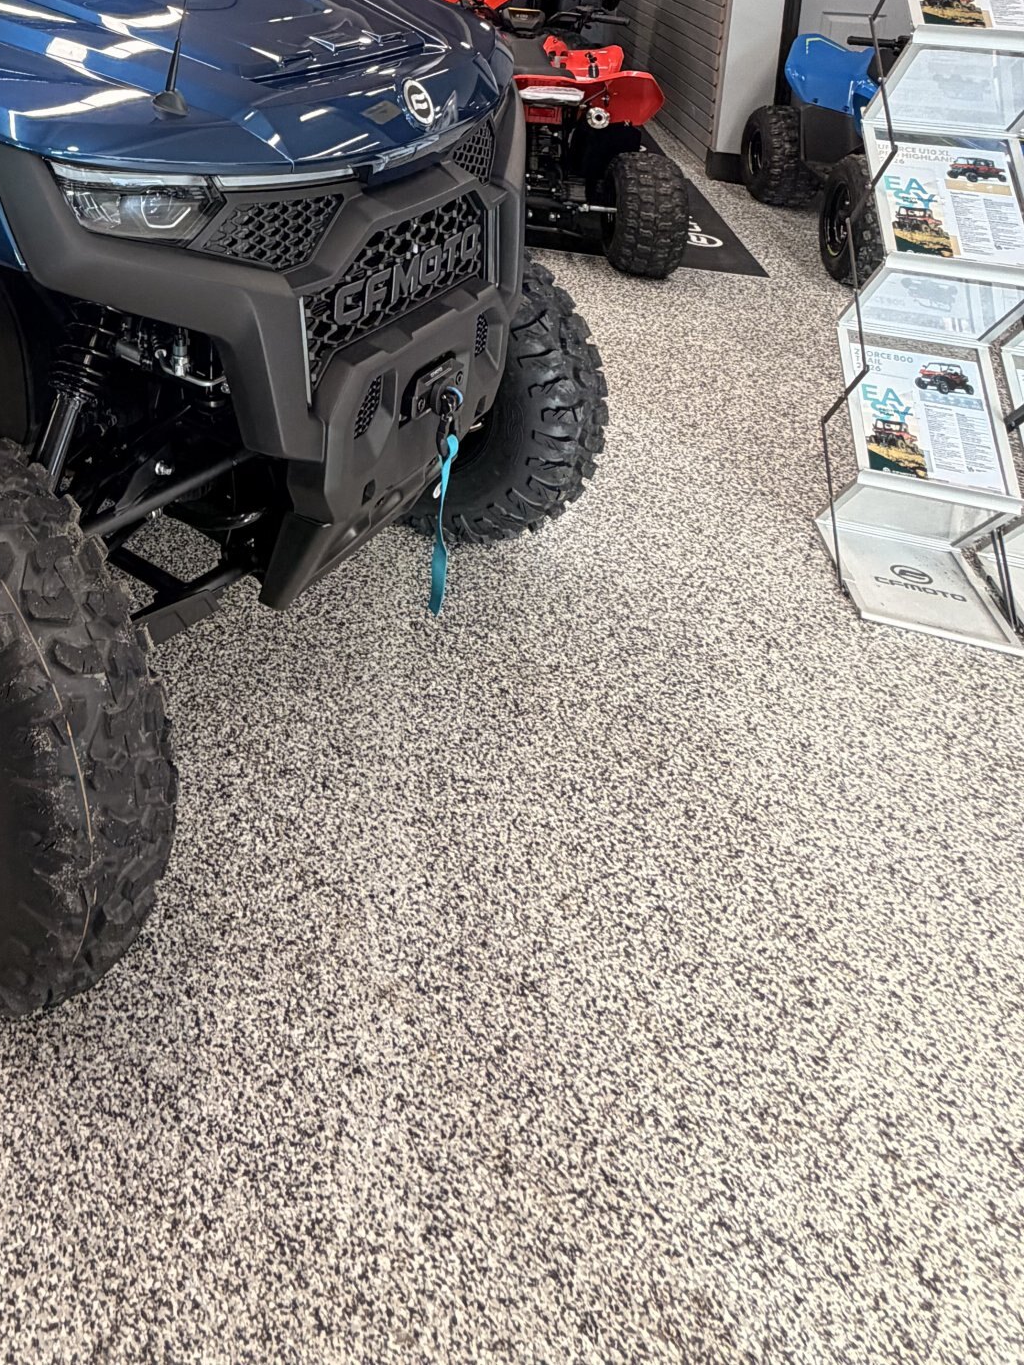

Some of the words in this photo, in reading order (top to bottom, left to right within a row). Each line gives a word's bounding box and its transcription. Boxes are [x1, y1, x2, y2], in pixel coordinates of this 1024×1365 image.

[878, 144, 917, 154] UFRCE
[919, 147, 936, 155] U10
[334, 224, 480, 326] CFMOTO
[854, 348, 892, 361] ZORCE
[893, 355, 913, 364] 800
[856, 356, 883, 366] TAIL
[856, 363, 882, 372] 226
[874, 575, 967, 602] CFMOTO
